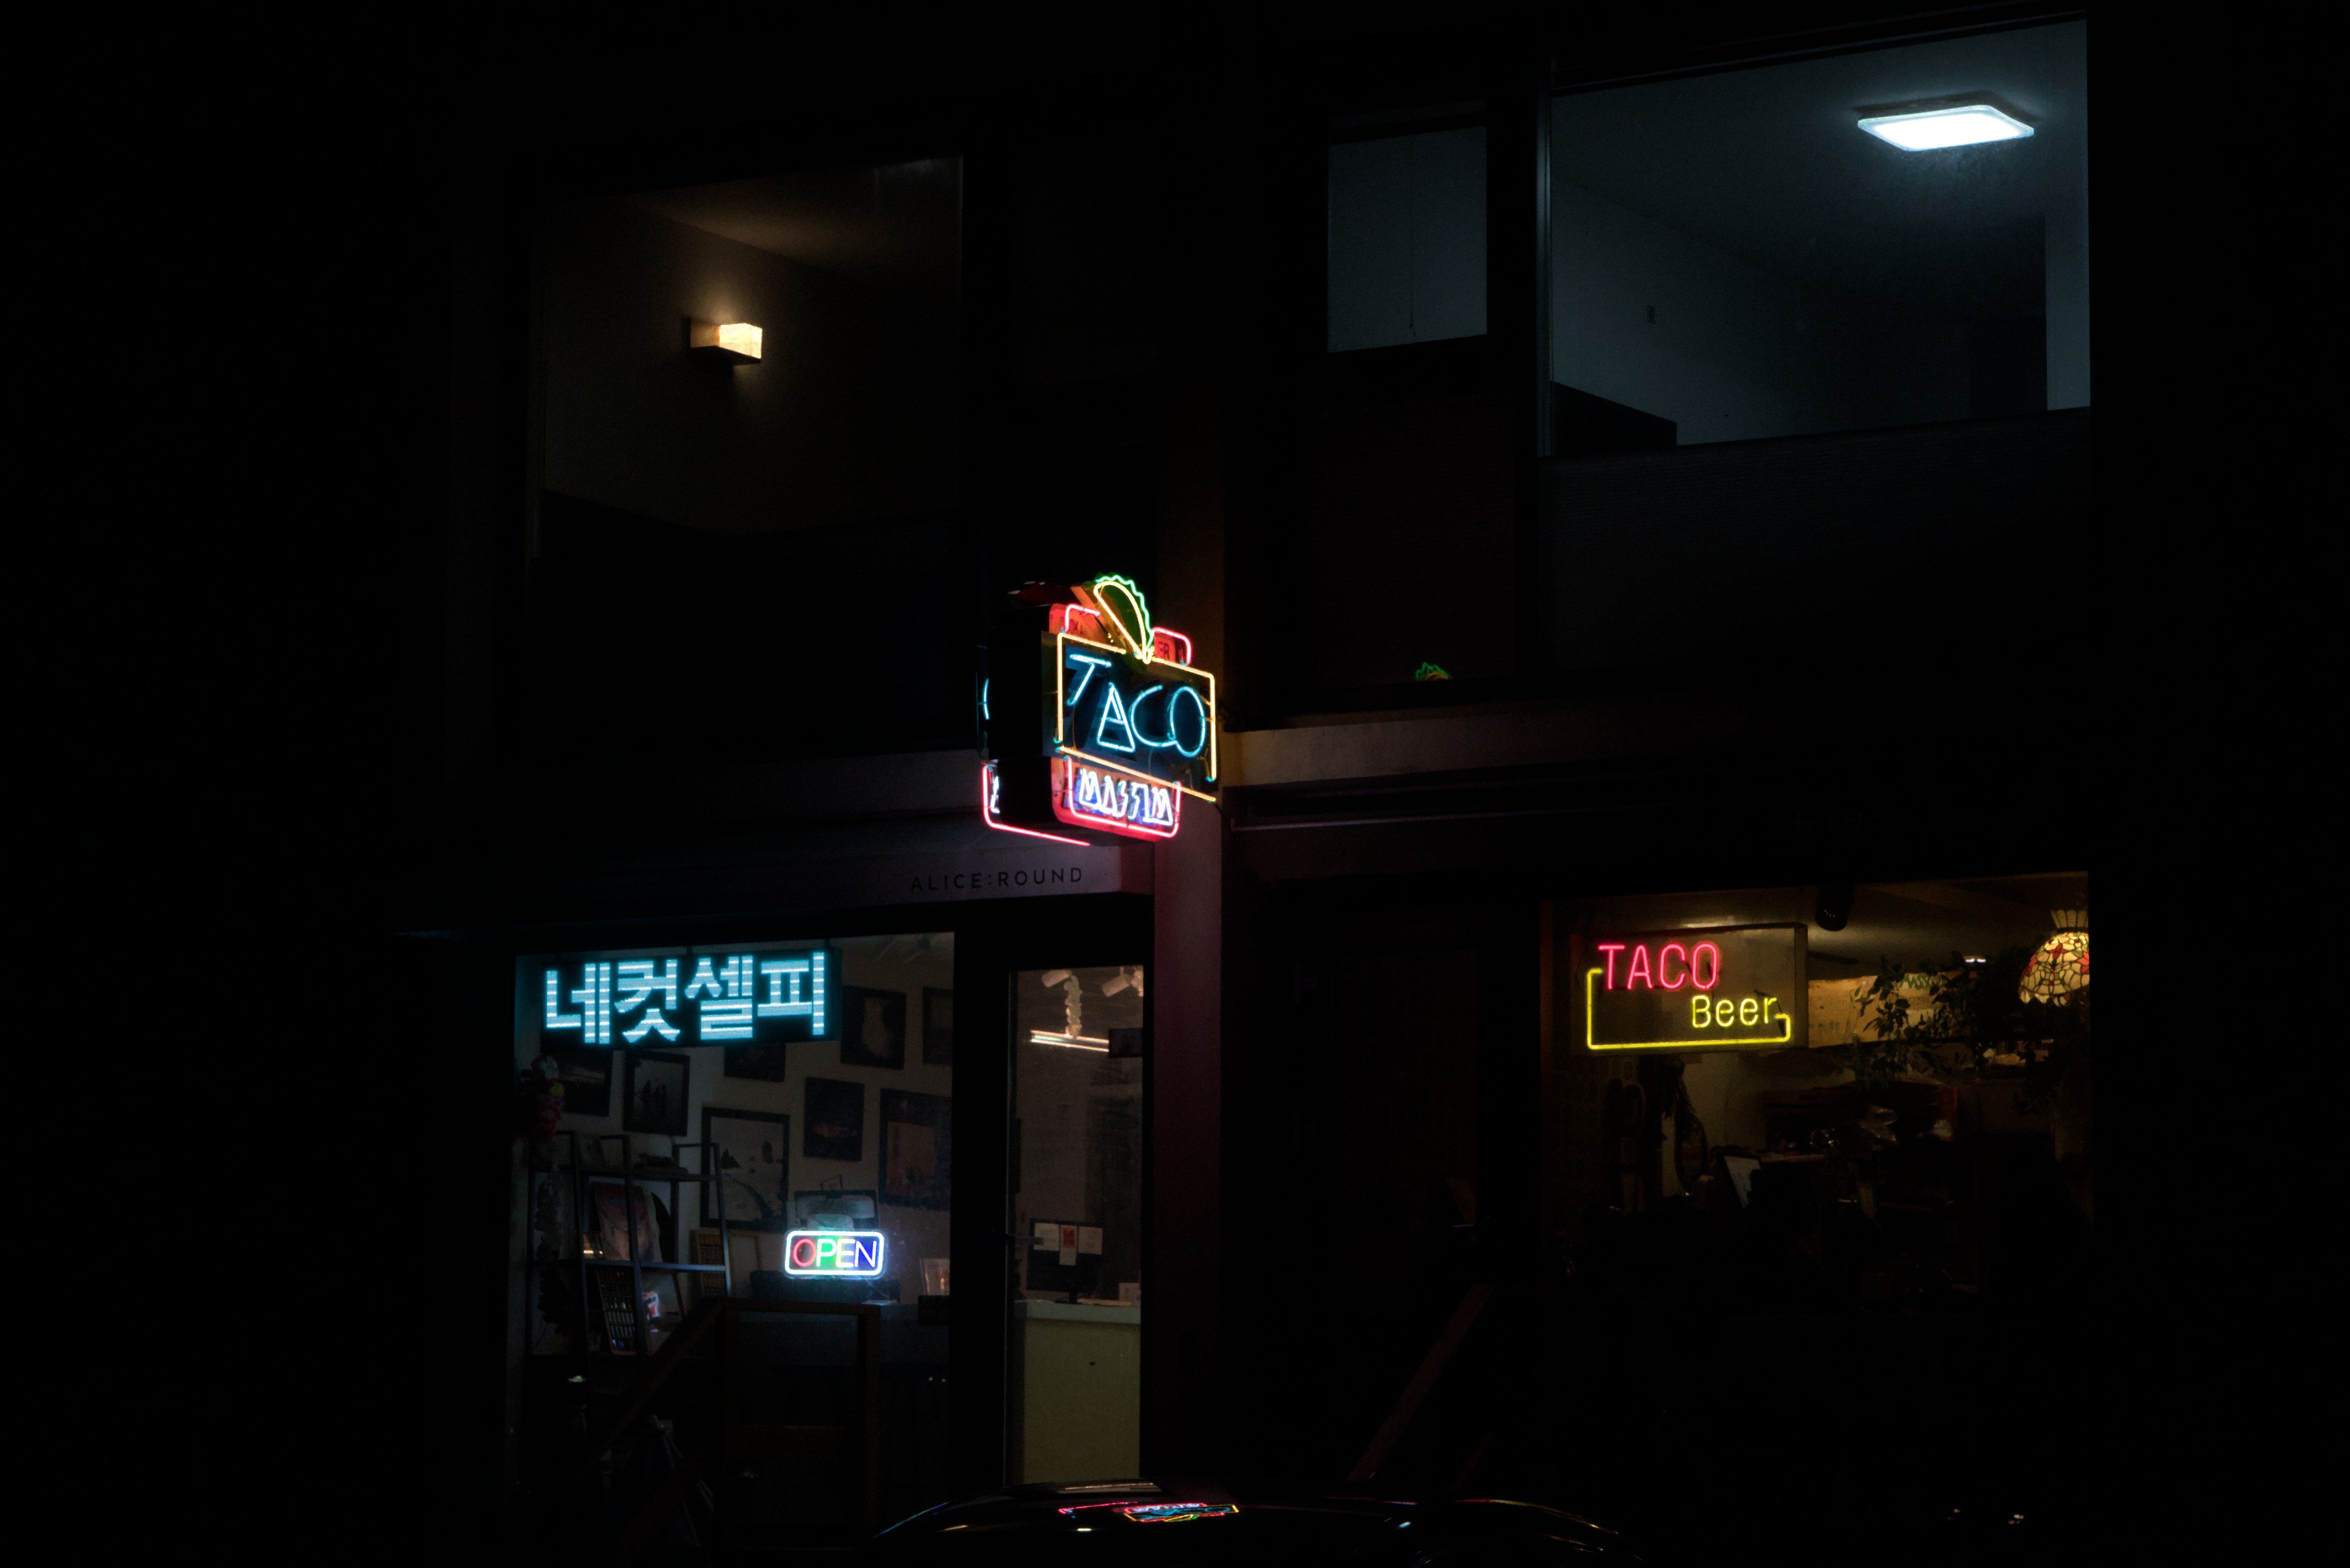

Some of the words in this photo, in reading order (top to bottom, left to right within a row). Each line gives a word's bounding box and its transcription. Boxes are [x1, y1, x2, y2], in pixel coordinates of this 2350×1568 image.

[1069, 652, 1206, 758] TACO
[1597, 941, 1720, 990] TACO
[545, 951, 825, 1044] 네컷셀피
[1692, 994, 1777, 1028] Beer
[793, 1238, 877, 1268] OPEN
